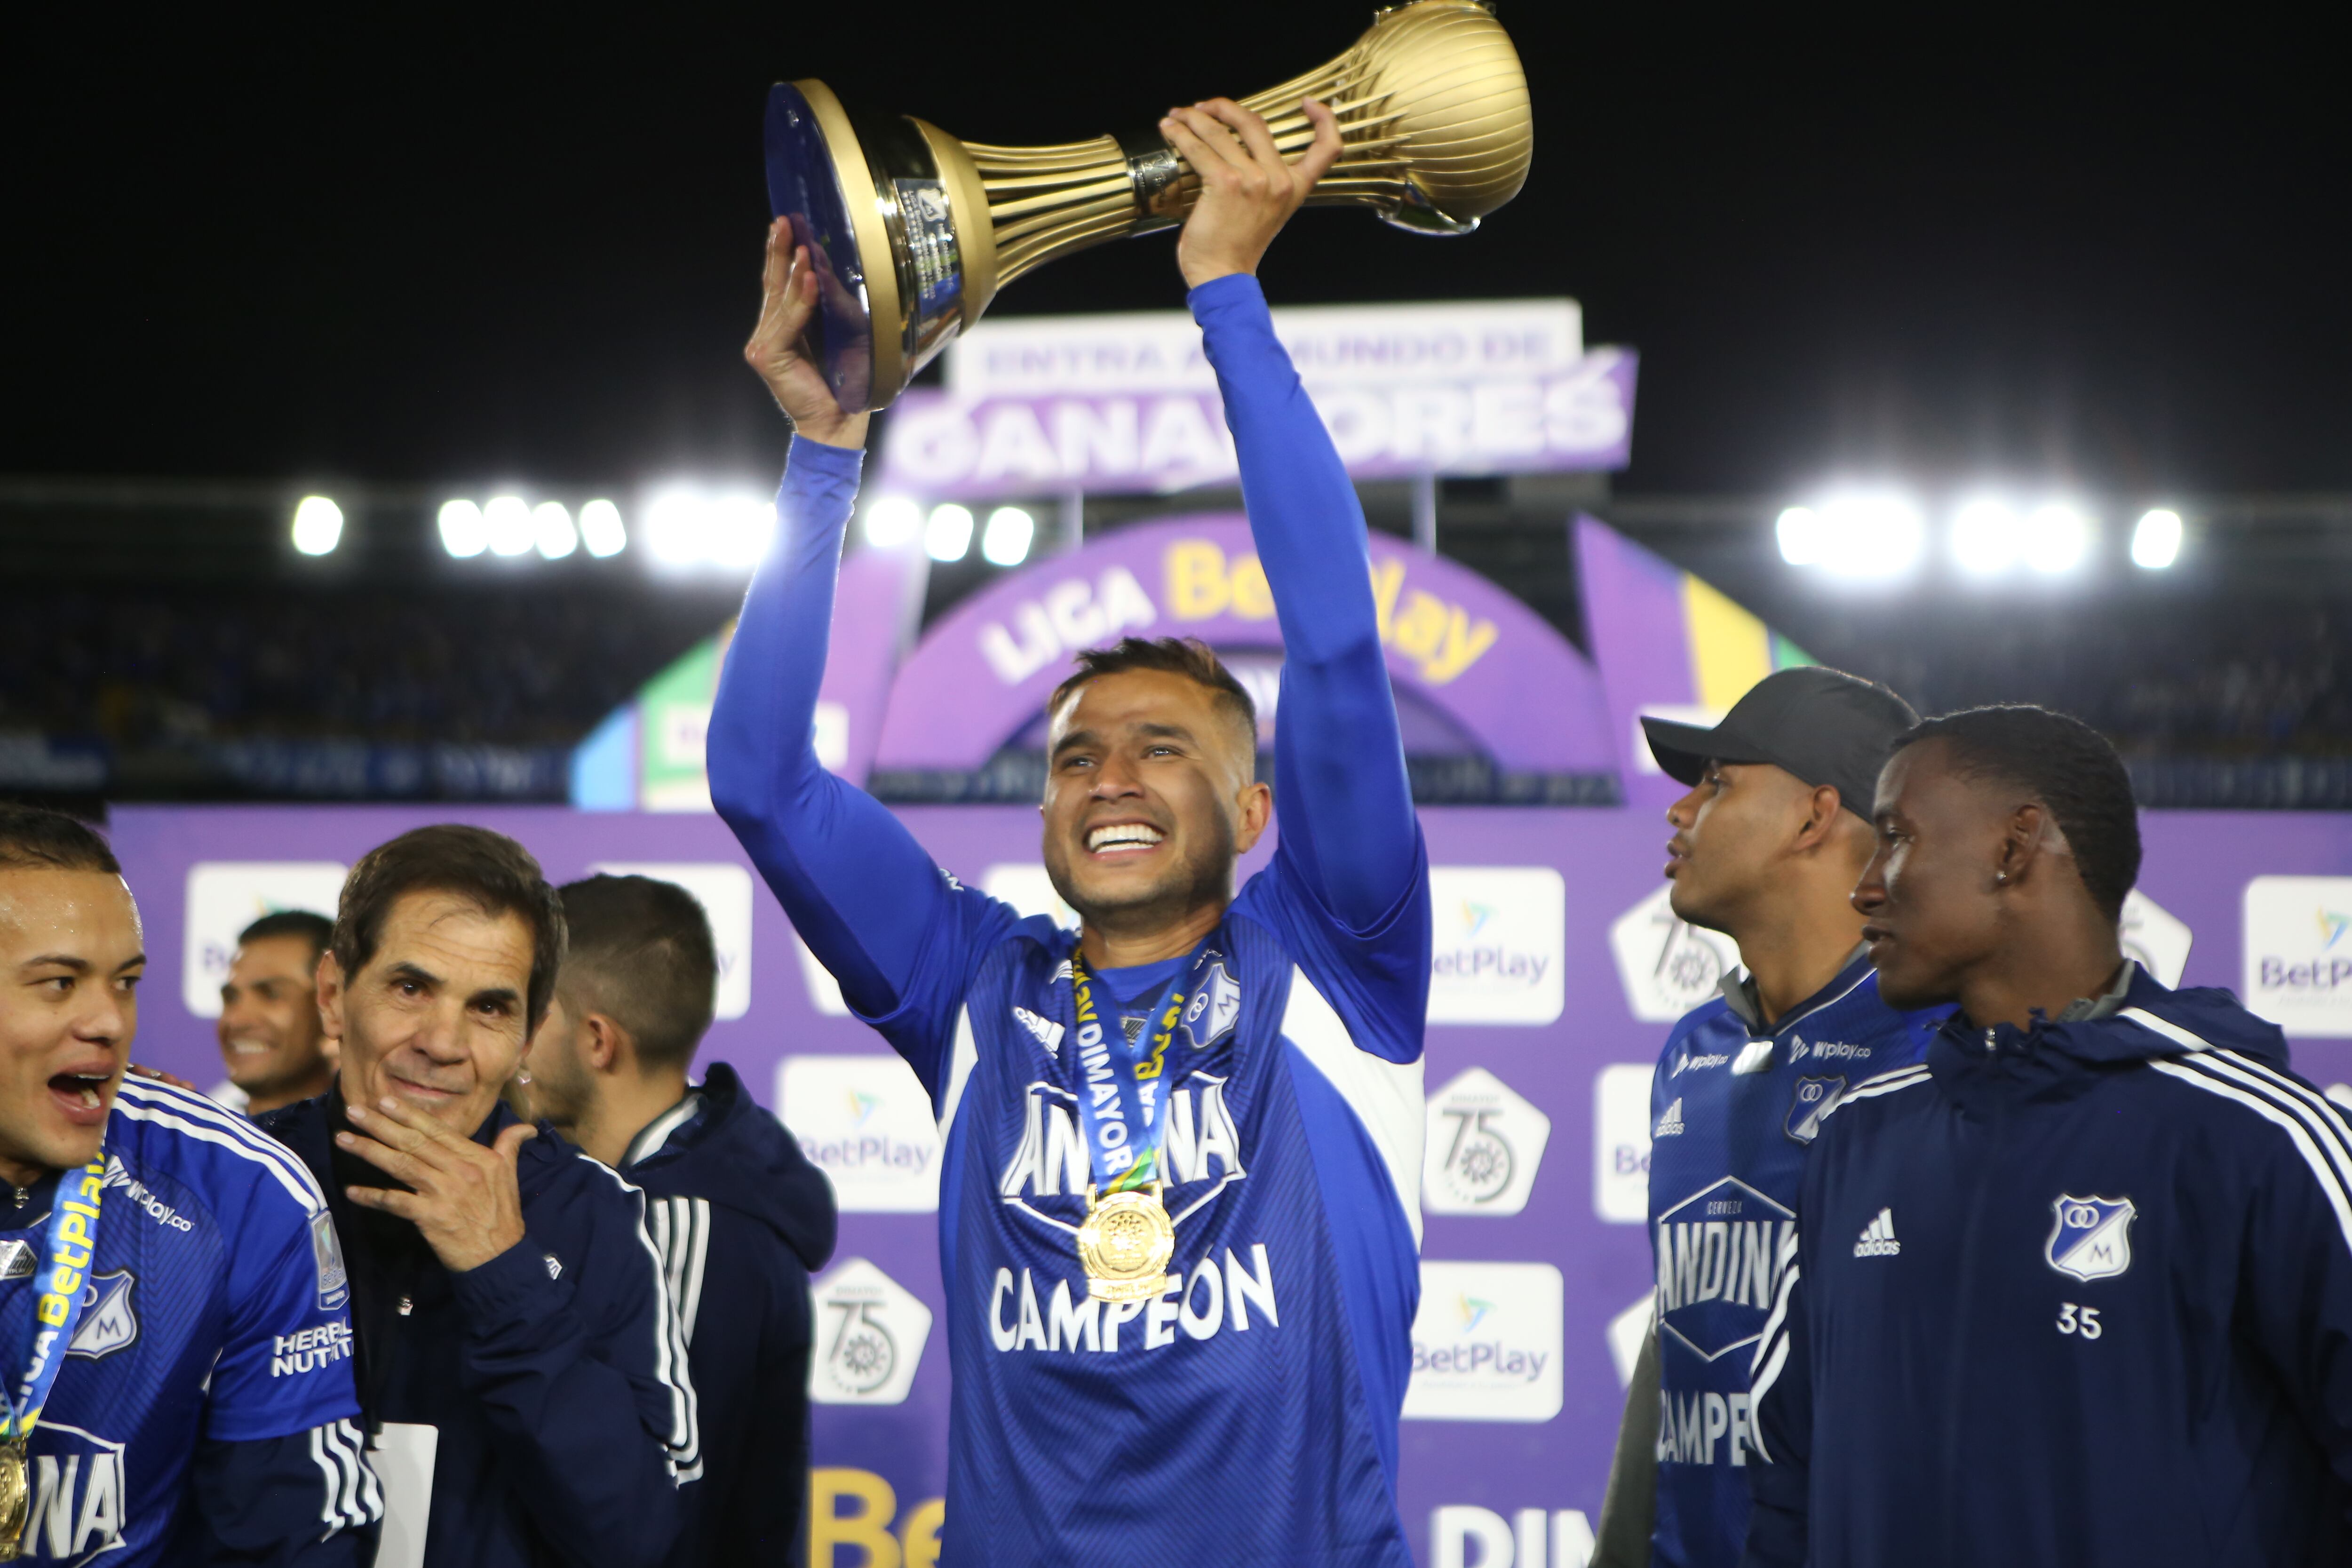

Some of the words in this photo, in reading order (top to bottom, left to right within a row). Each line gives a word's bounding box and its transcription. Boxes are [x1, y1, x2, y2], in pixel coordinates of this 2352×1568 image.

[1483, 328, 1551, 362] DE
[885, 378, 1628, 481] GANAORES
[981, 566, 1156, 685] LIGA
[1165, 540, 1498, 684] Belay
[1434, 944, 1549, 987] etPlay
[1002, 1083, 1237, 1196] ANNA
[1078, 1023, 1134, 1175] DIMAYOR
[1442, 1108, 1518, 1204] 75
[1853, 1238, 1900, 1258] adidas
[827, 1300, 900, 1394] 75
[2056, 1301, 2102, 1340] 35
